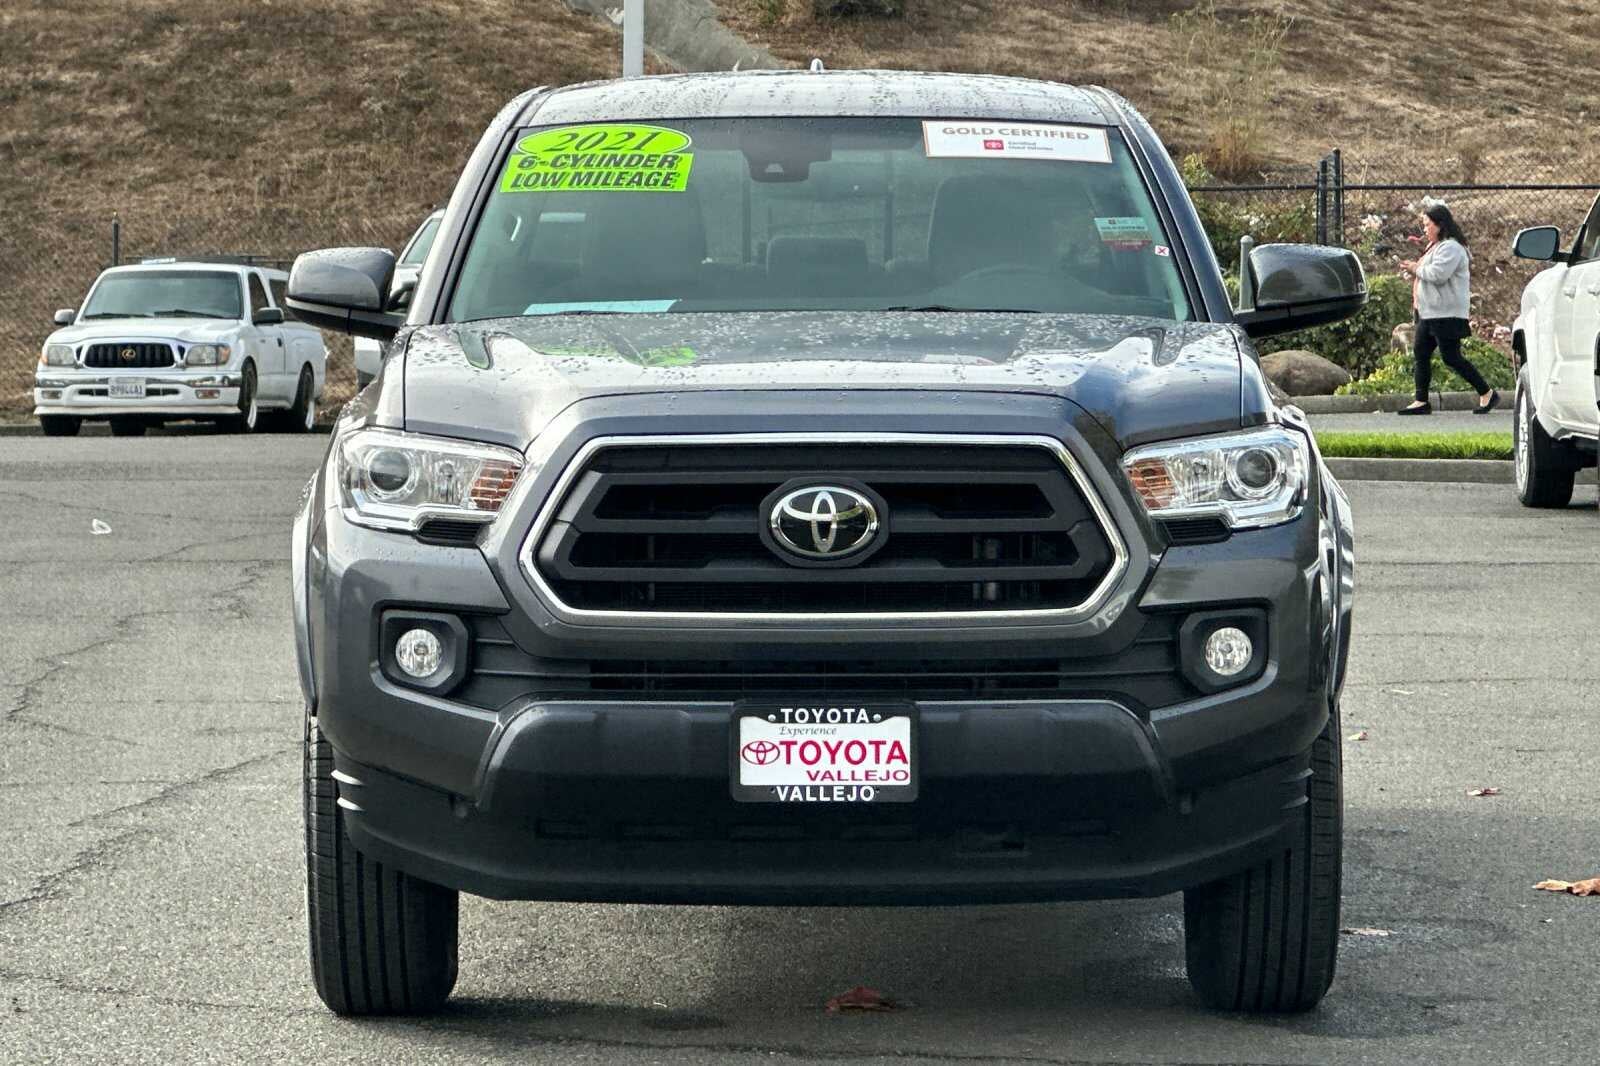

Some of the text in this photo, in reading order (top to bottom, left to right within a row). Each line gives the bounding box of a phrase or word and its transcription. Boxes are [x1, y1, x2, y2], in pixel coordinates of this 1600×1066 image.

[544, 131, 662, 152] 2021
[942, 127, 1089, 140] GOLD CERTIFIED
[517, 153, 681, 170] 6-CYLINDER
[510, 171, 679, 188] LOW MILEAGE
[780, 708, 870, 724] TOYOTA
[779, 726, 837, 737] Experience
[779, 740, 908, 765] TOYOTA
[806, 770, 909, 782] VALLEJO
[776, 785, 875, 801] VALLEJO
